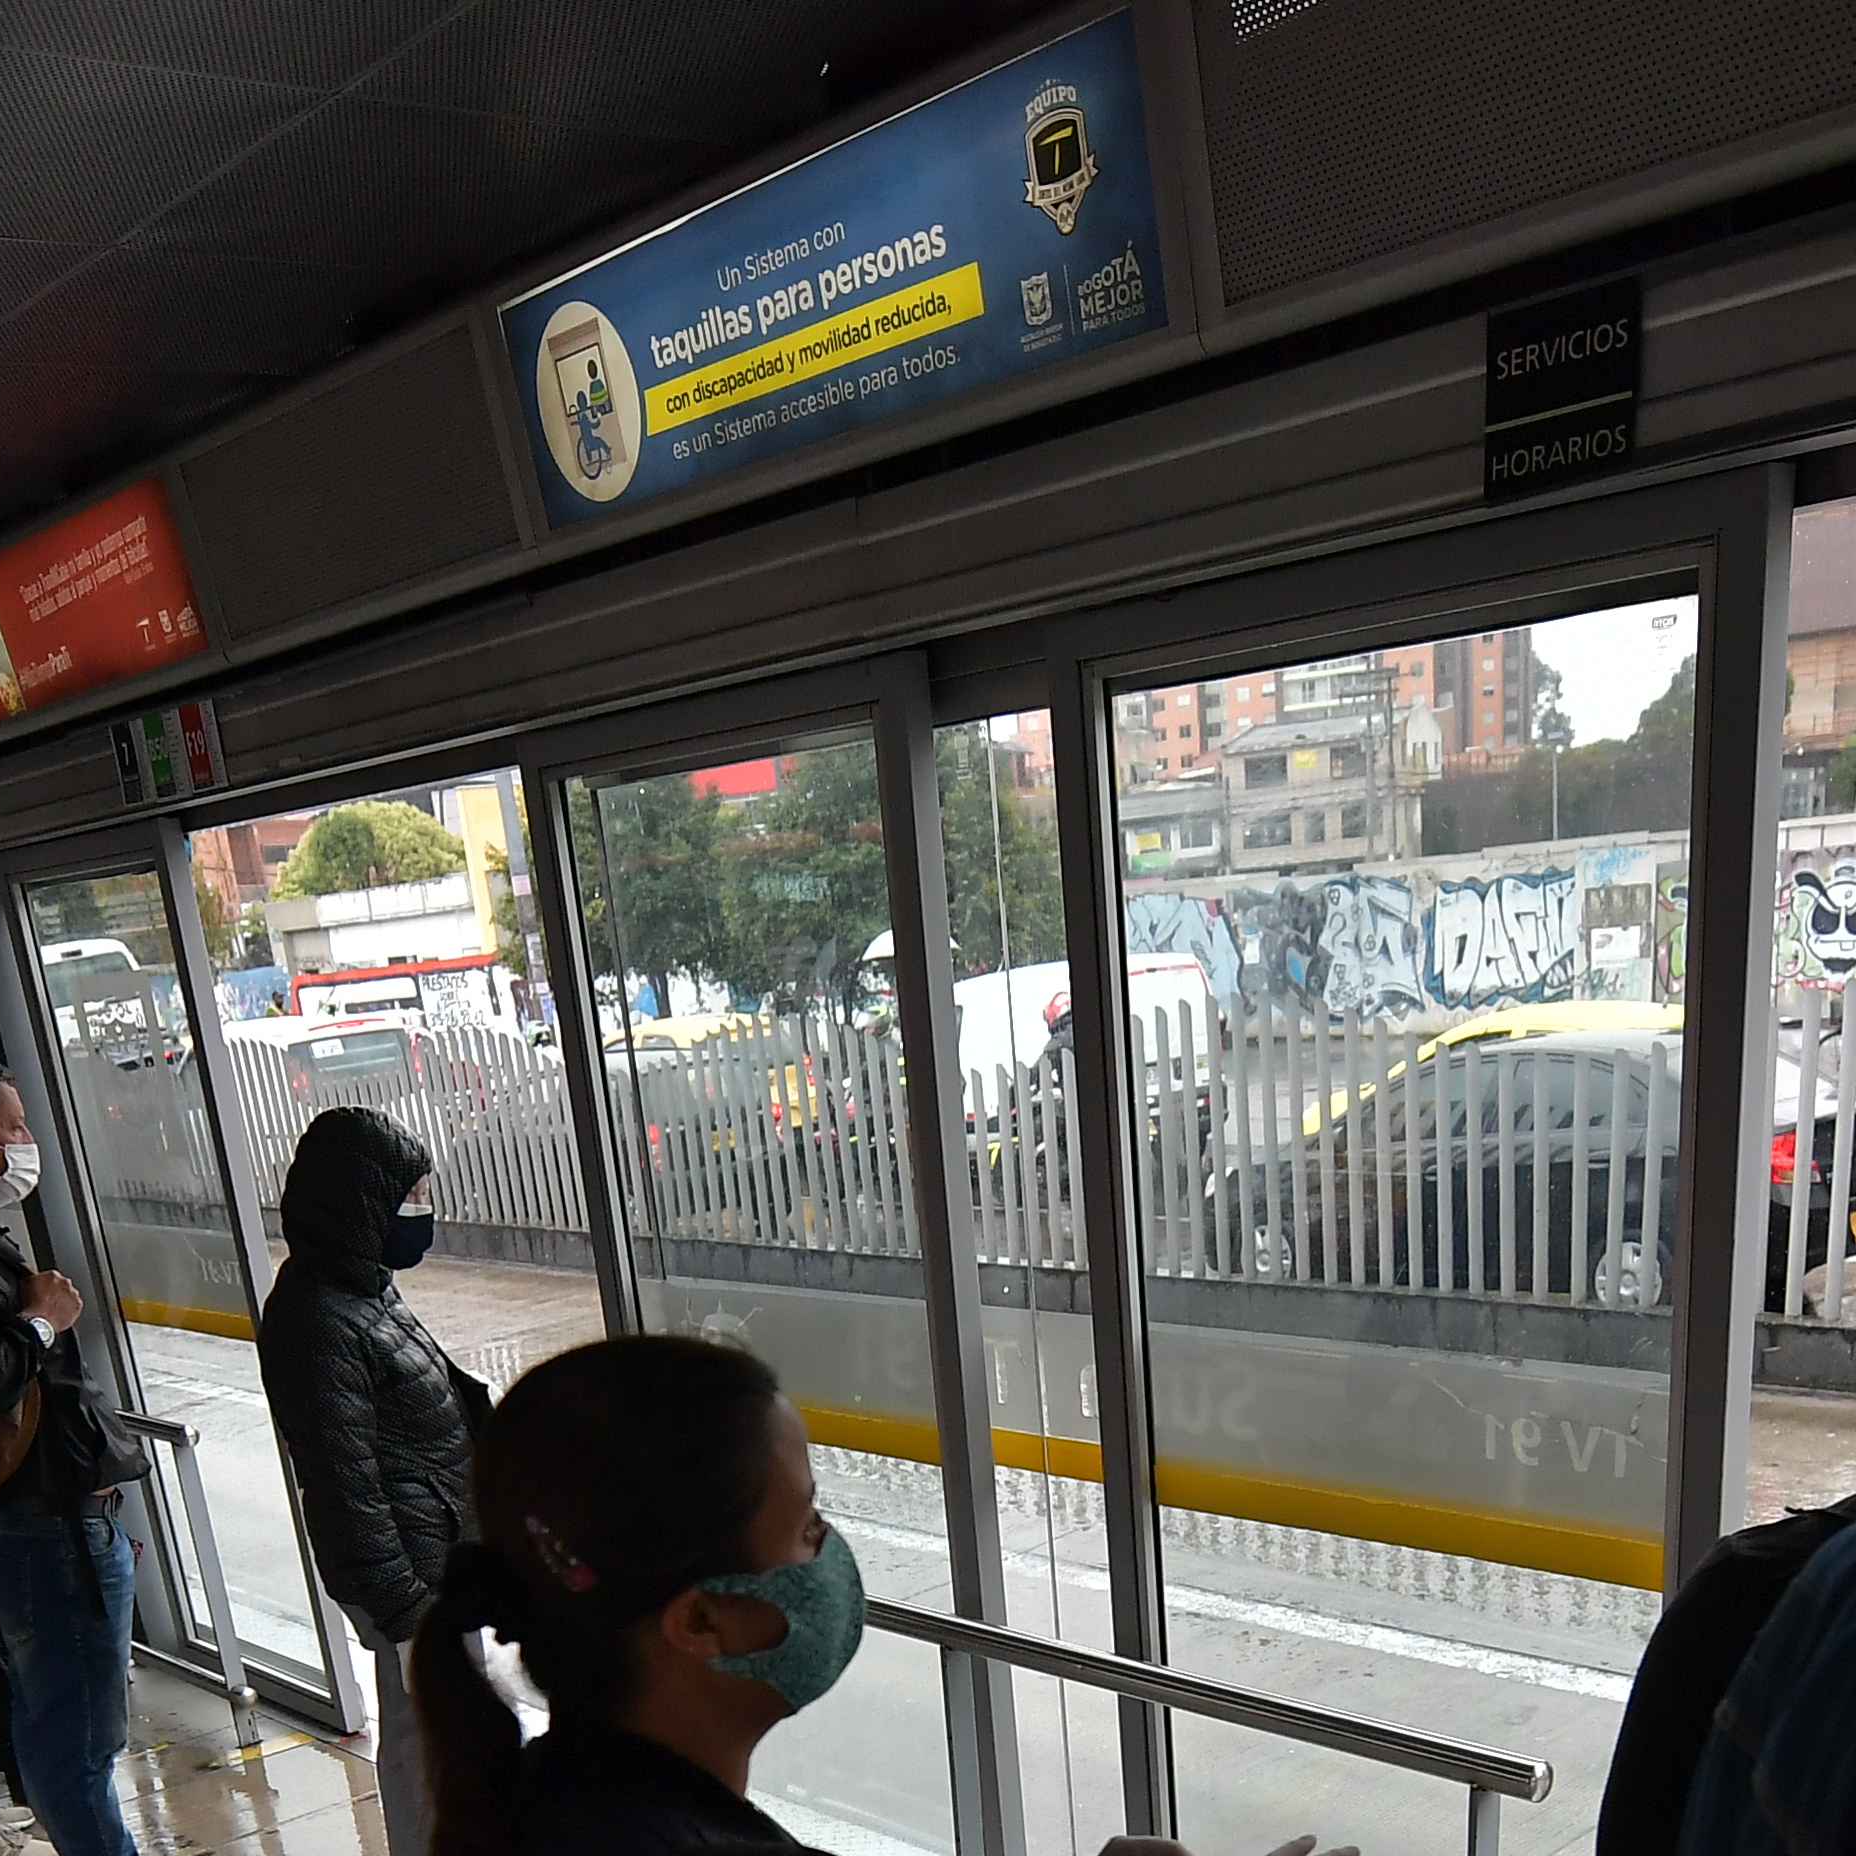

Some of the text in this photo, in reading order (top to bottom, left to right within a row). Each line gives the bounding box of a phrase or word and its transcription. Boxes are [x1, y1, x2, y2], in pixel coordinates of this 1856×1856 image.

[1026, 85, 1077, 122] EQUIPO
[717, 221, 845, 292] Un Sistema con
[1077, 240, 1141, 295] BOGOTÁ
[649, 222, 948, 369] taquillas para personas
[1079, 280, 1143, 320] MEJOR
[665, 291, 952, 415] con discapacidad y movilidad reducida,
[1497, 318, 1629, 380] SERVICIOS
[672, 343, 962, 460] es un Sistema accesible para todos.
[1491, 424, 1627, 480] HORARIOS
[184, 729, 206, 757] F19
